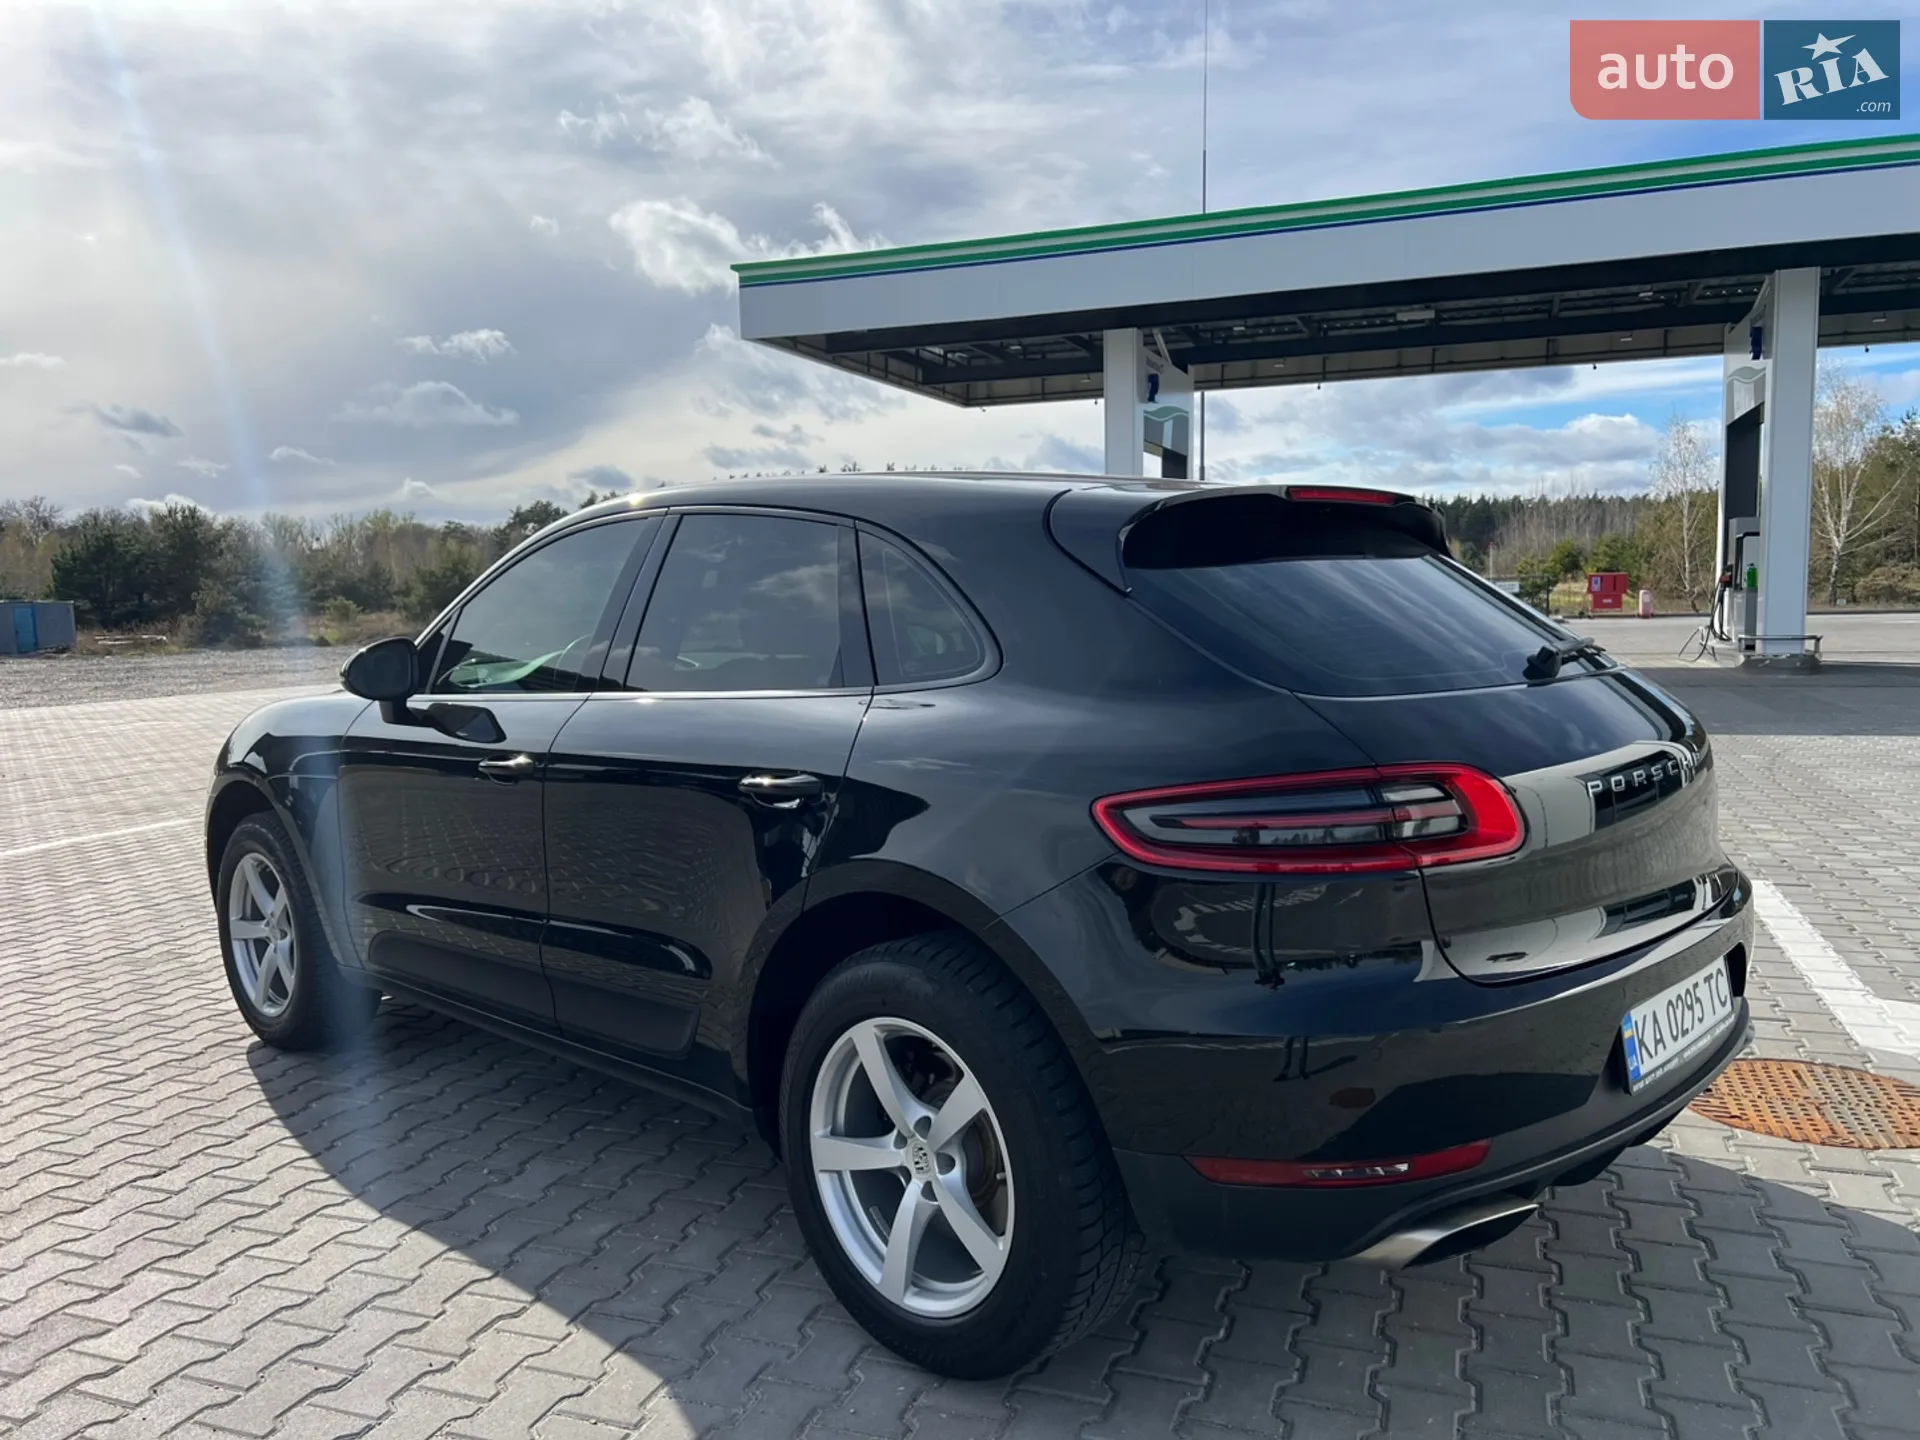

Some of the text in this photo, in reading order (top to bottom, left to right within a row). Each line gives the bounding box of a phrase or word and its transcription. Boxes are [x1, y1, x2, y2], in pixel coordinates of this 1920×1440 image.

[1635, 1009, 1667, 1065] KA
[1666, 982, 1705, 1042] 0295
[1704, 967, 1728, 1016] TC
